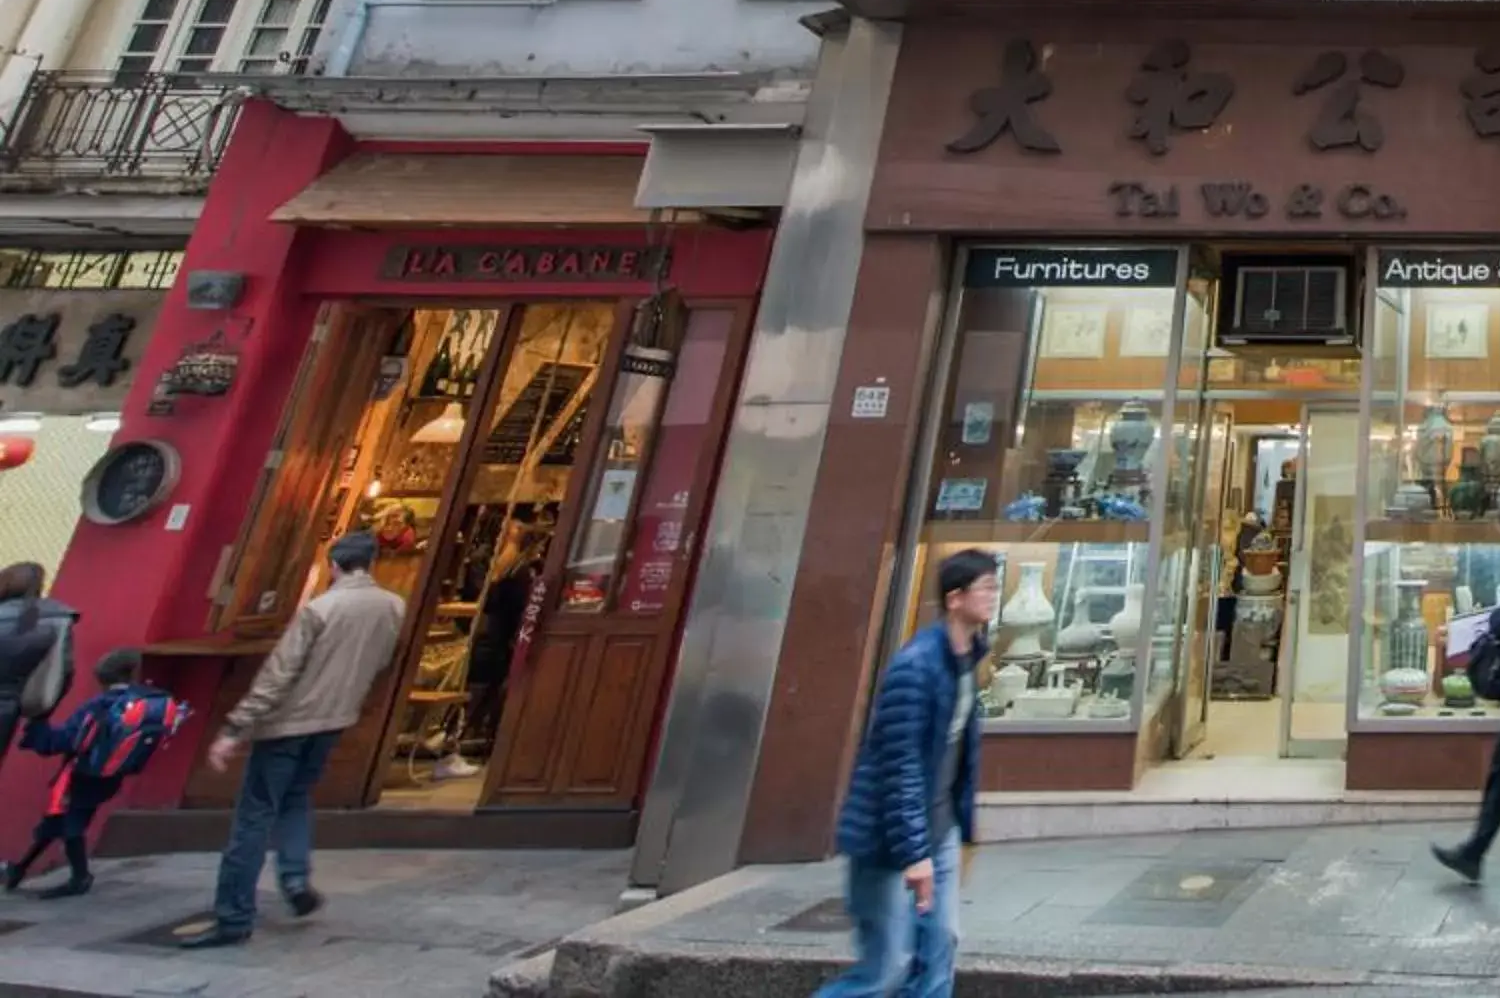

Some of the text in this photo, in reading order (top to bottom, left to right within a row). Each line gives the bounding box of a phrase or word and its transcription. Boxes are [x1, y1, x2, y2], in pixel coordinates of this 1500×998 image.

[1108, 182, 1408, 219] Tai Wo & Co.
[405, 252, 640, 274] LA CABANE
[994, 257, 1150, 280] Furnitures
[1384, 257, 1490, 285] Antique
